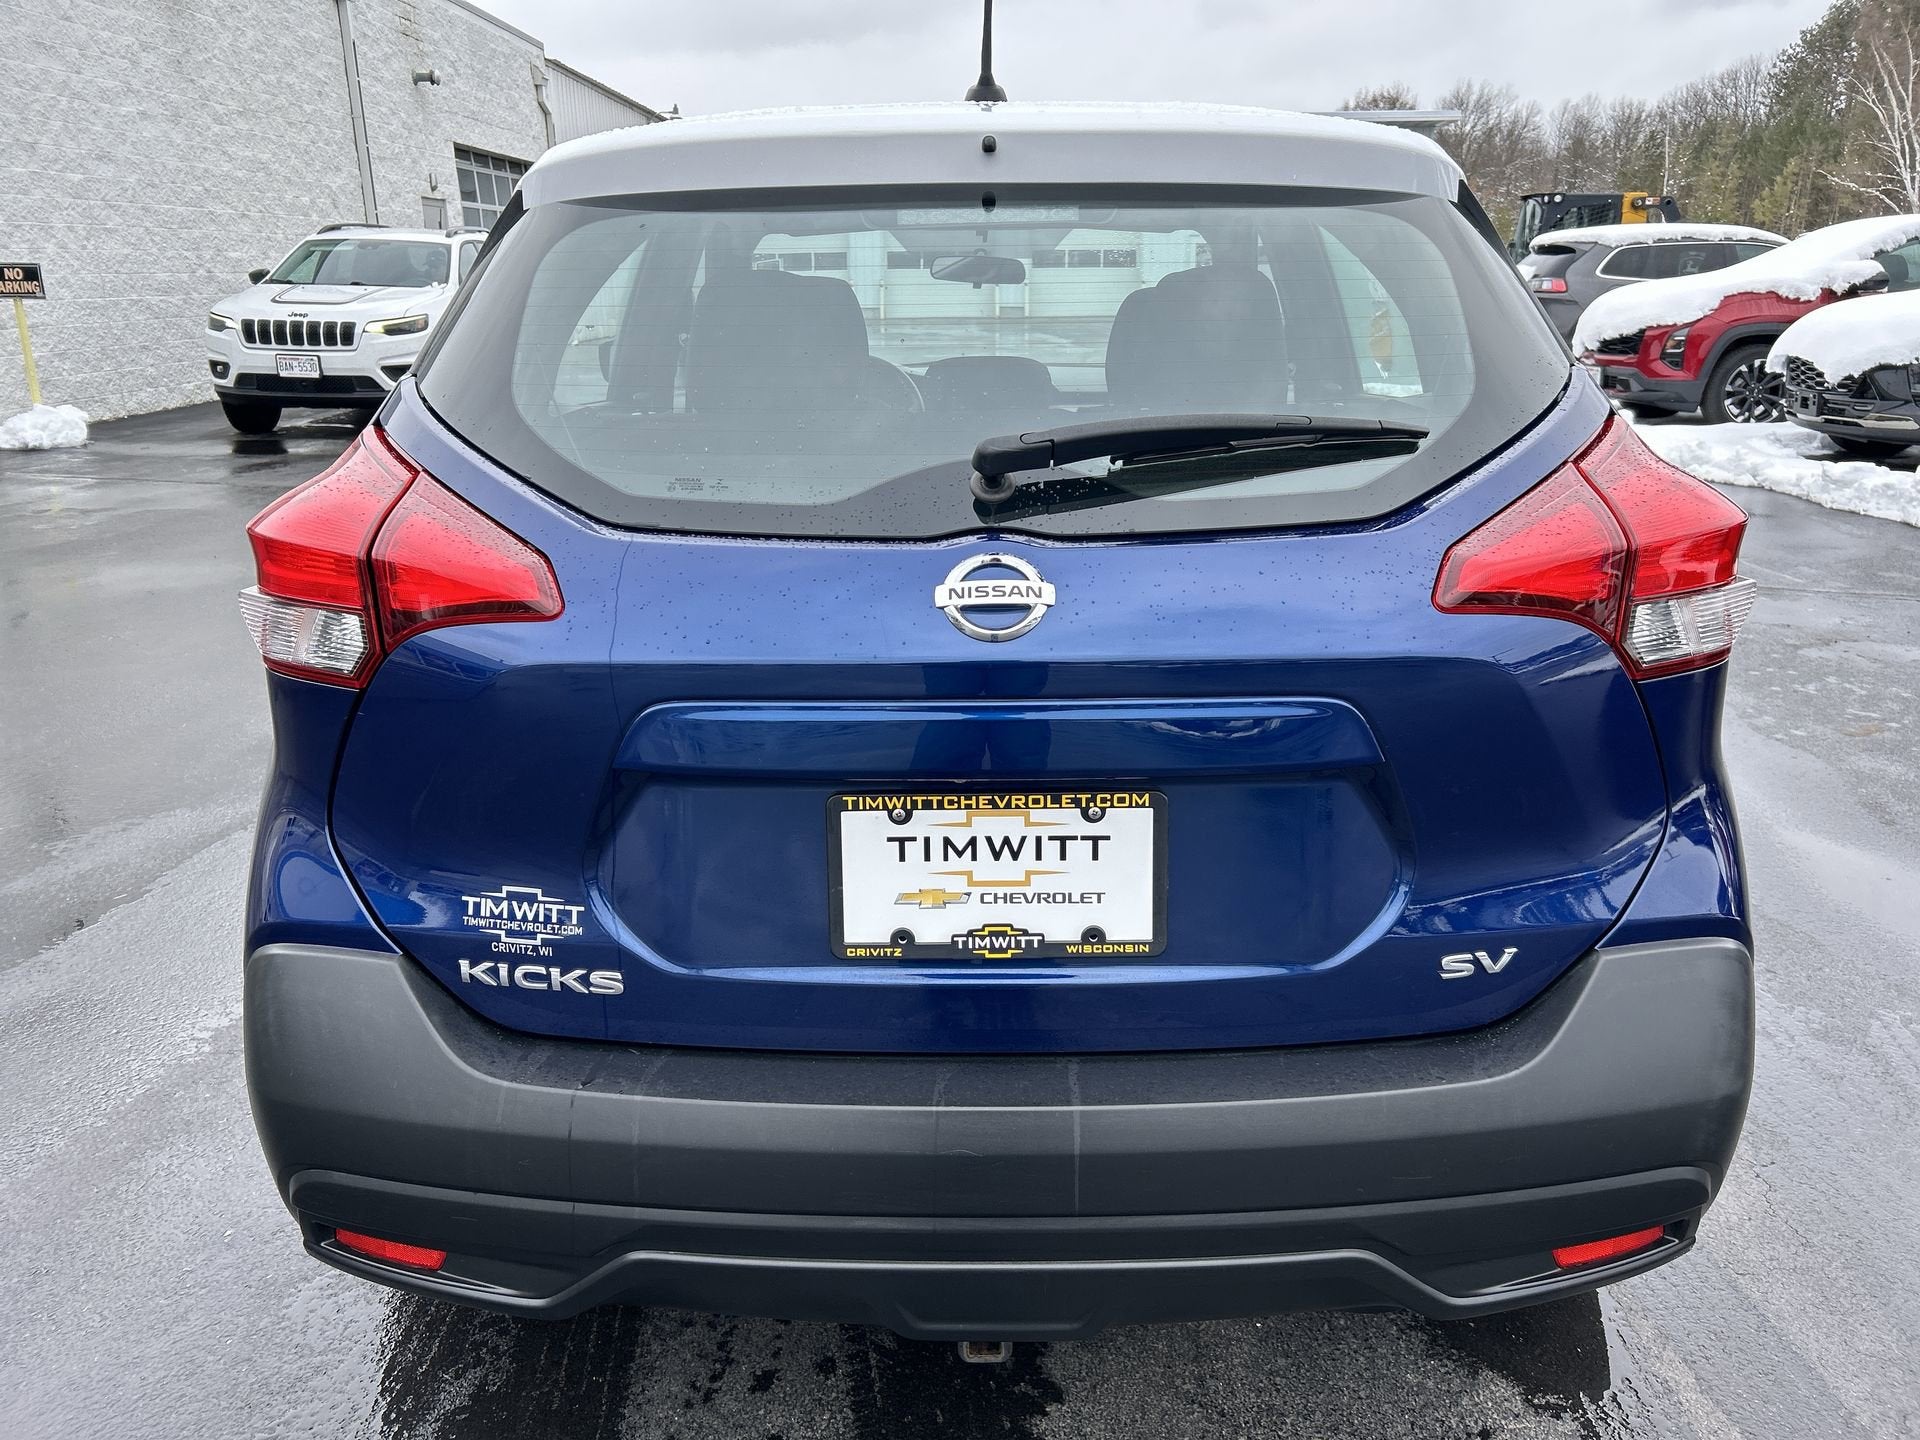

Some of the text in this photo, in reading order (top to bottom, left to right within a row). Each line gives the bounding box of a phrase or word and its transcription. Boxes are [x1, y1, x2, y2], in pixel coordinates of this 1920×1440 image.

[3, 267, 23, 280] NO
[0, 280, 40, 293] ARKING
[279, 361, 318, 373] BAN-5530
[948, 585, 1042, 600] NISSAN
[843, 793, 1150, 810] TIMWITTCHEVROLET.COM
[886, 835, 1111, 862] TIMWITT
[979, 892, 1106, 905] CHEVROLET
[462, 916, 583, 936] TIMWITTCHEVROLET.COM
[491, 942, 553, 957] CRIVITZ, WI
[953, 935, 1043, 950] TIMWITT
[1066, 944, 1149, 953] WISCONSIN
[846, 947, 903, 957] CRIVITZ
[1439, 947, 1519, 980] SV
[458, 959, 624, 995] KICKS
